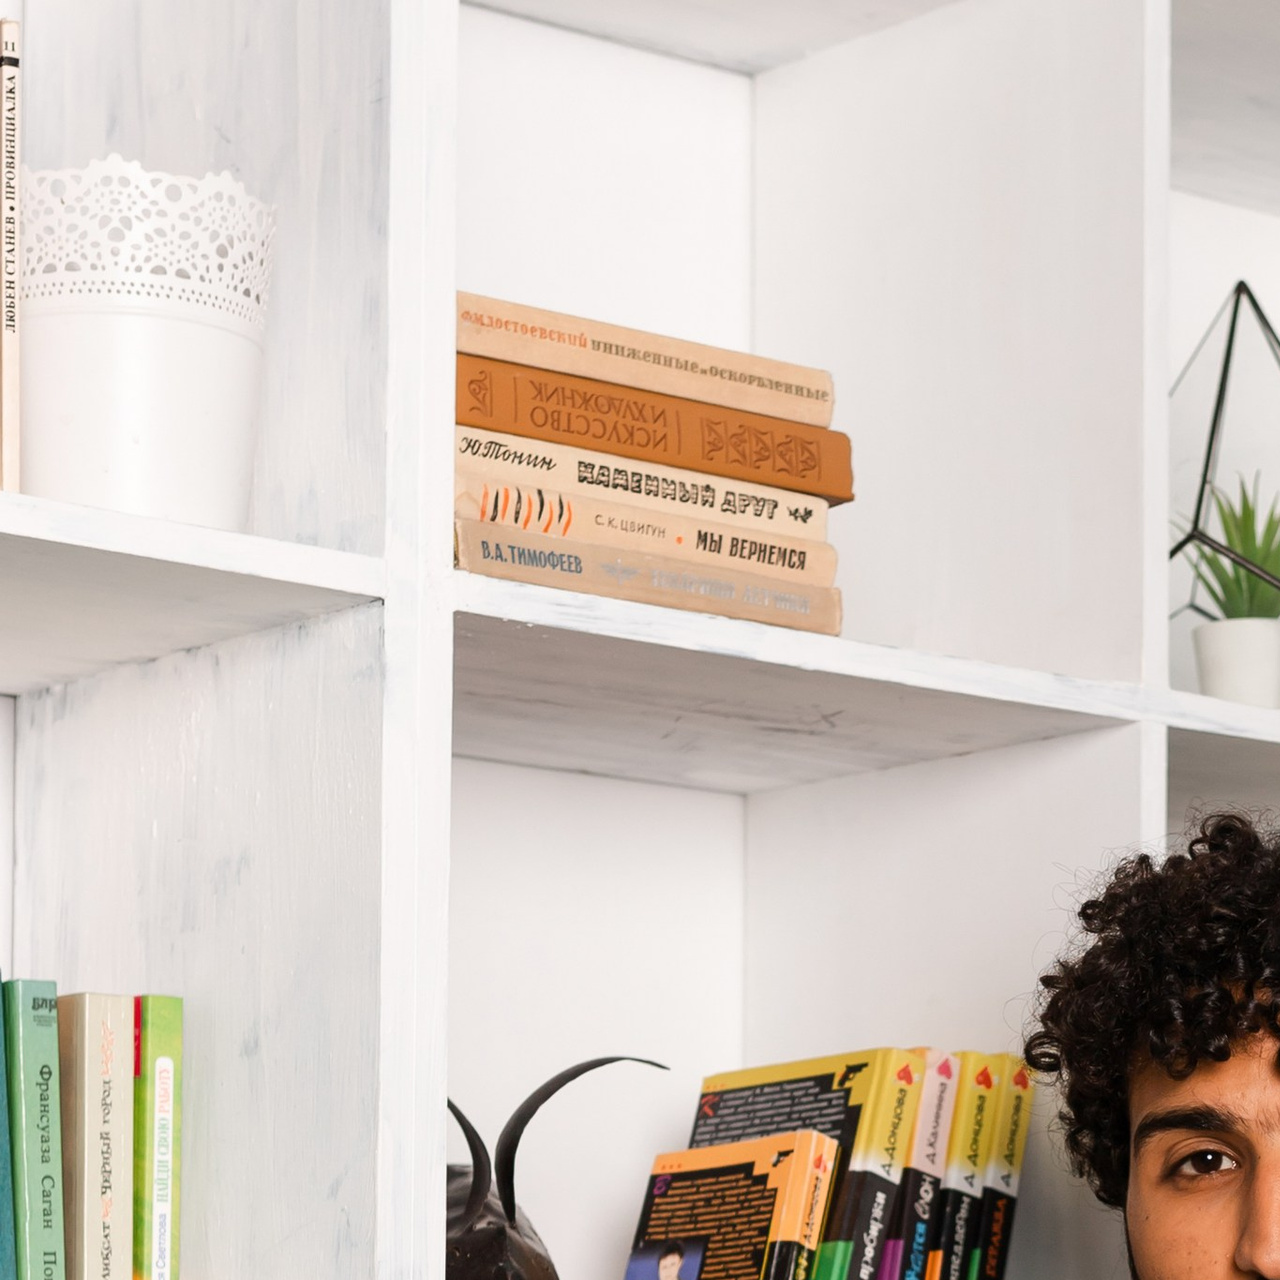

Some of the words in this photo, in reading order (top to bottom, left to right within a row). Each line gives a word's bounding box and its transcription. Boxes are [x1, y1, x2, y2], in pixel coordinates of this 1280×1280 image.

[5, 74, 16, 201] ПРОВИНЦИАЛКА
[5, 216, 16, 276] СТАНЕВ
[5, 279, 16, 333] ЛЮБЕН
[529, 378, 654, 420] ХУДОЖНИК
[530, 405, 669, 453] ИСКУССТВО
[577, 460, 716, 506] КАМЕННЫЙ
[721, 490, 779, 519] ДРУГ
[696, 530, 723, 555] МЫ
[729, 534, 808, 571] ВЕРНЕМСЯ
[36, 1064, 54, 1163] Франсуаза
[157, 1067, 171, 1113] РАБОТУ
[156, 1117, 170, 1155] СВОЮ
[39, 1174, 56, 1229] Саган
[155, 1159, 170, 1202] НАЙДИ
[155, 1213, 167, 1268] Светлова
